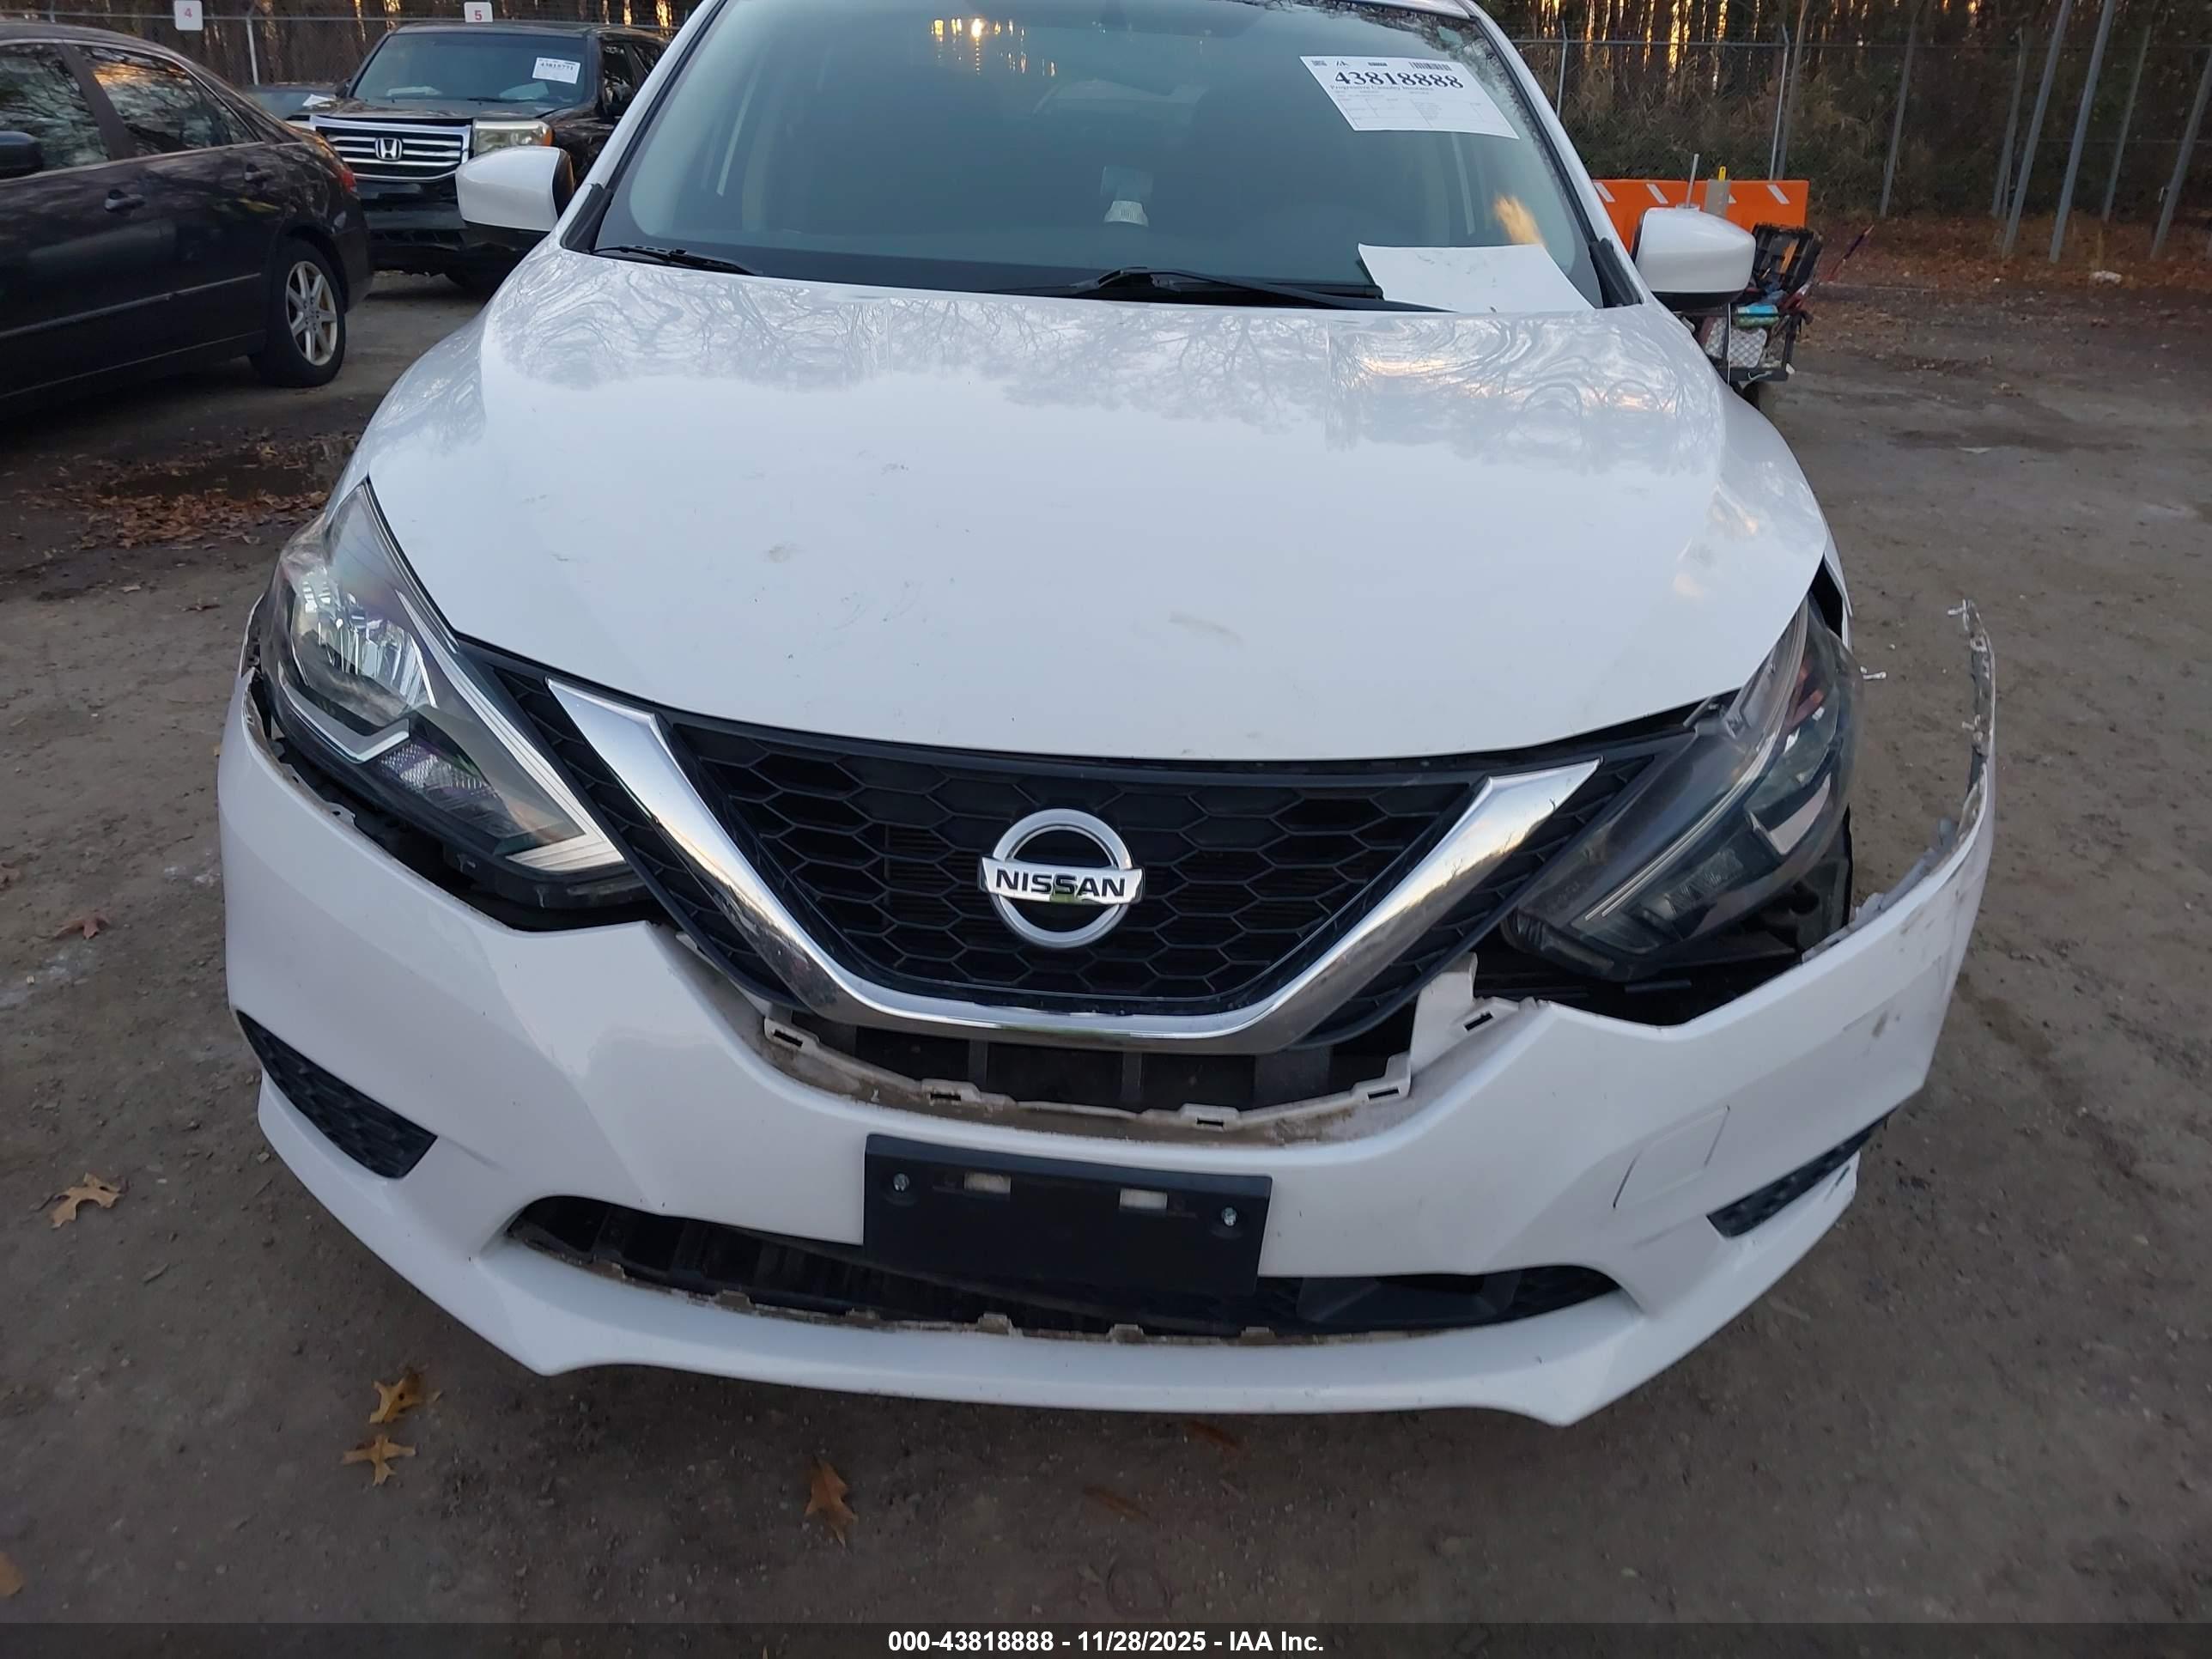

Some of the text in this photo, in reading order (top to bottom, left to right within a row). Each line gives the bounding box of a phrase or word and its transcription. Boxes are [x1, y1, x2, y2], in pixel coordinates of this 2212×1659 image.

[185, 8, 192, 18] 4
[474, 9, 483, 21] 5
[1335, 71, 1464, 88] 43818888
[996, 869, 1125, 896] NISSAN
